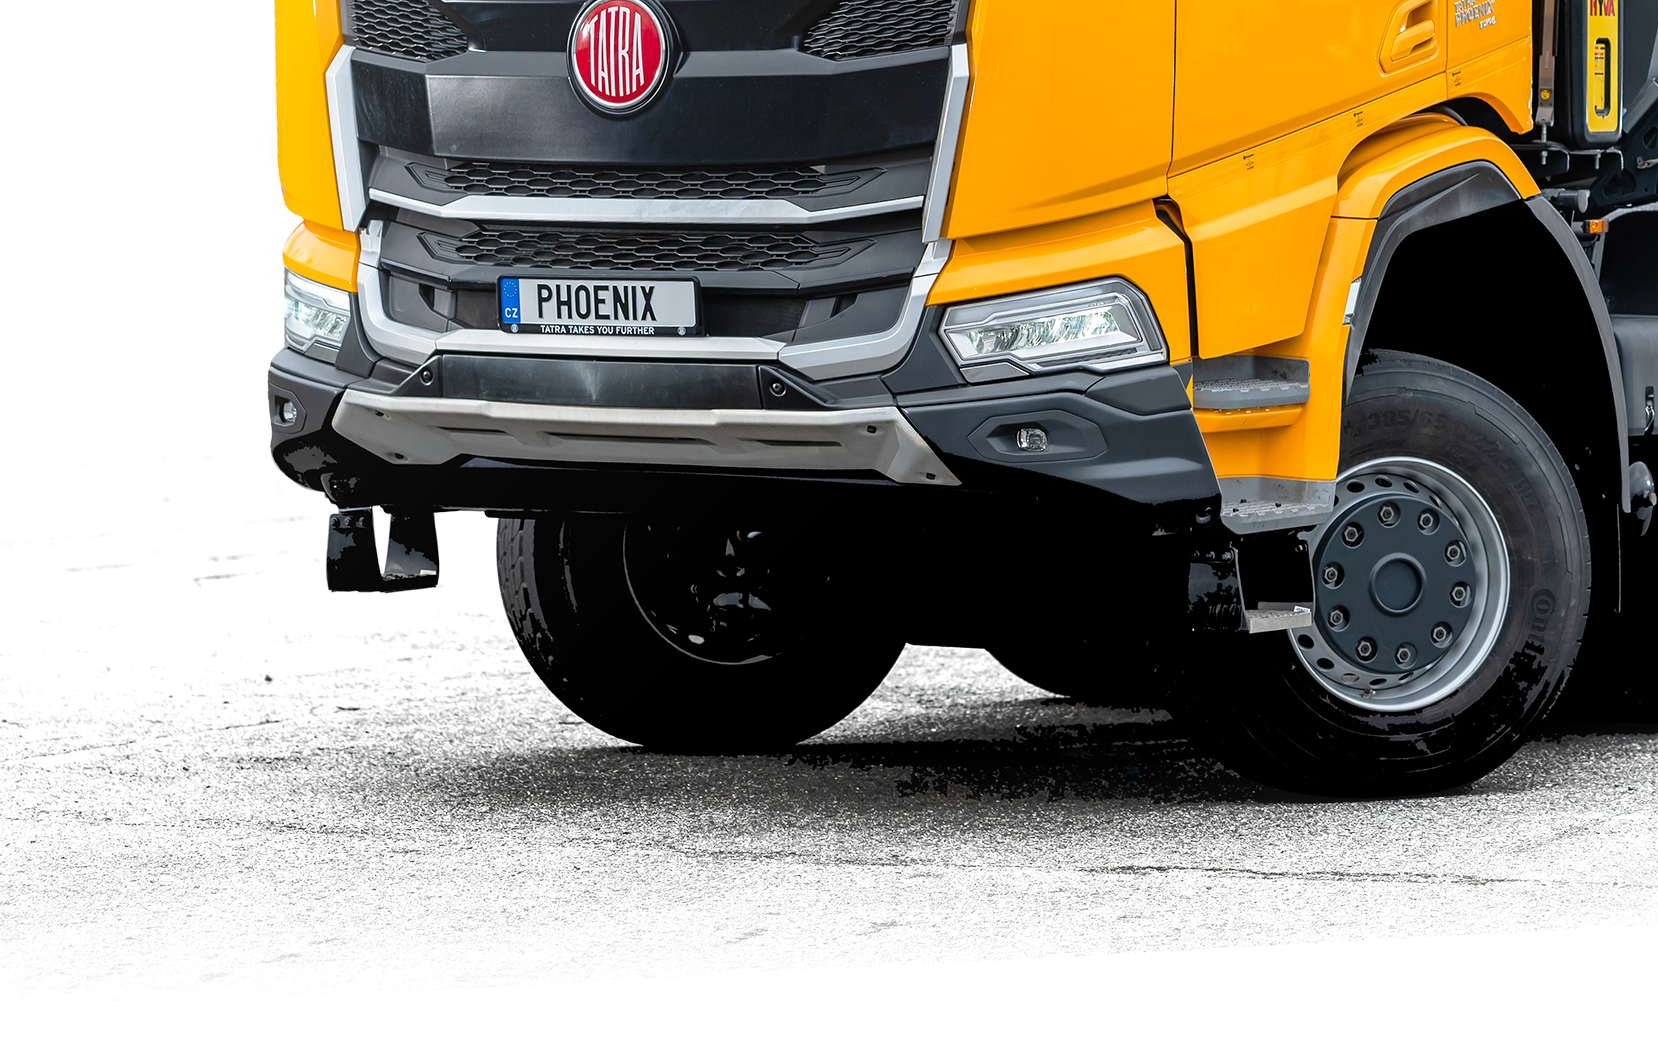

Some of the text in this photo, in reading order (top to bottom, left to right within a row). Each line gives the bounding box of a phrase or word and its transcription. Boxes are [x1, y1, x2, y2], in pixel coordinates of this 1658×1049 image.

[584, 6, 645, 97] TATRA
[504, 308, 518, 319] CZ
[536, 284, 657, 322] PHOENIX
[540, 325, 655, 335] TATRA TAKES YOU FURTHER
[1367, 408, 1448, 432] 385/65
